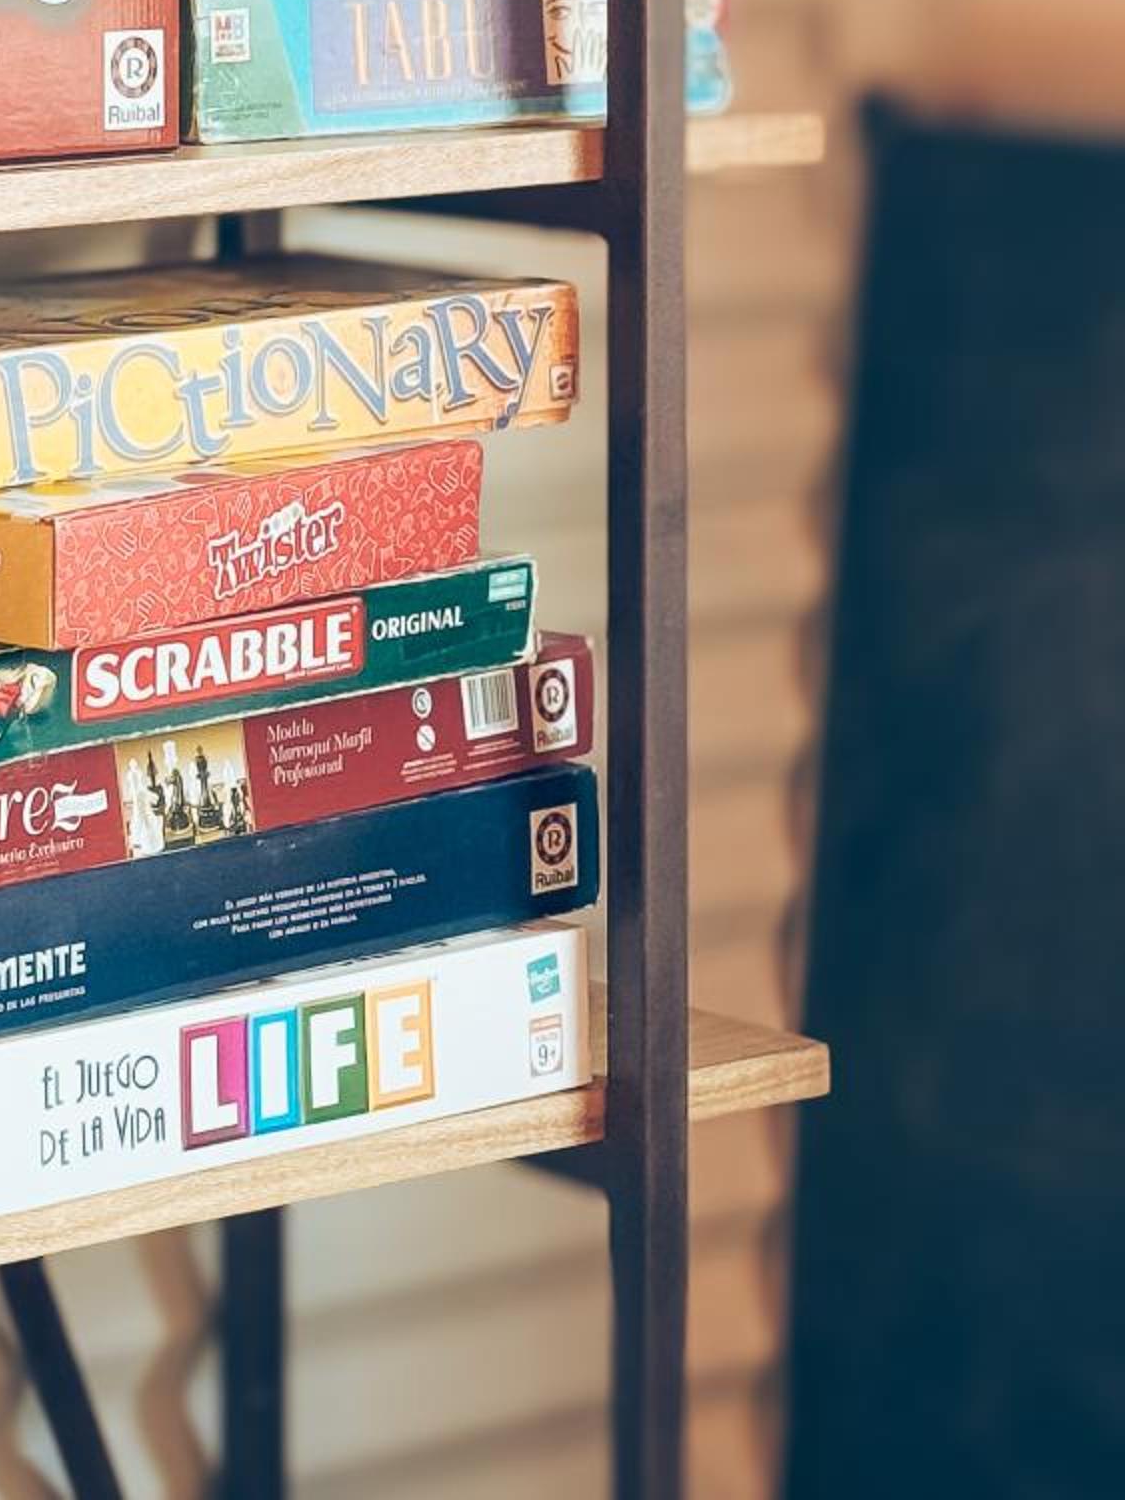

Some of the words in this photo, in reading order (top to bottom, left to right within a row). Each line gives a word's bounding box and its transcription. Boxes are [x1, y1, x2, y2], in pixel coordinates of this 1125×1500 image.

[107, 103, 160, 125] Ruibal
[209, 502, 345, 599] Twister
[372, 605, 464, 642] ORIGINAL
[83, 609, 354, 709] SCRABBLE
[266, 718, 314, 743] Modelo
[42, 1064, 64, 1110] EL
[75, 1054, 161, 1103] JUEGO
[187, 990, 427, 1138] LIFE
[39, 1129, 71, 1167] DE
[81, 1111, 105, 1158] LA
[113, 1104, 167, 1151] VIDA
